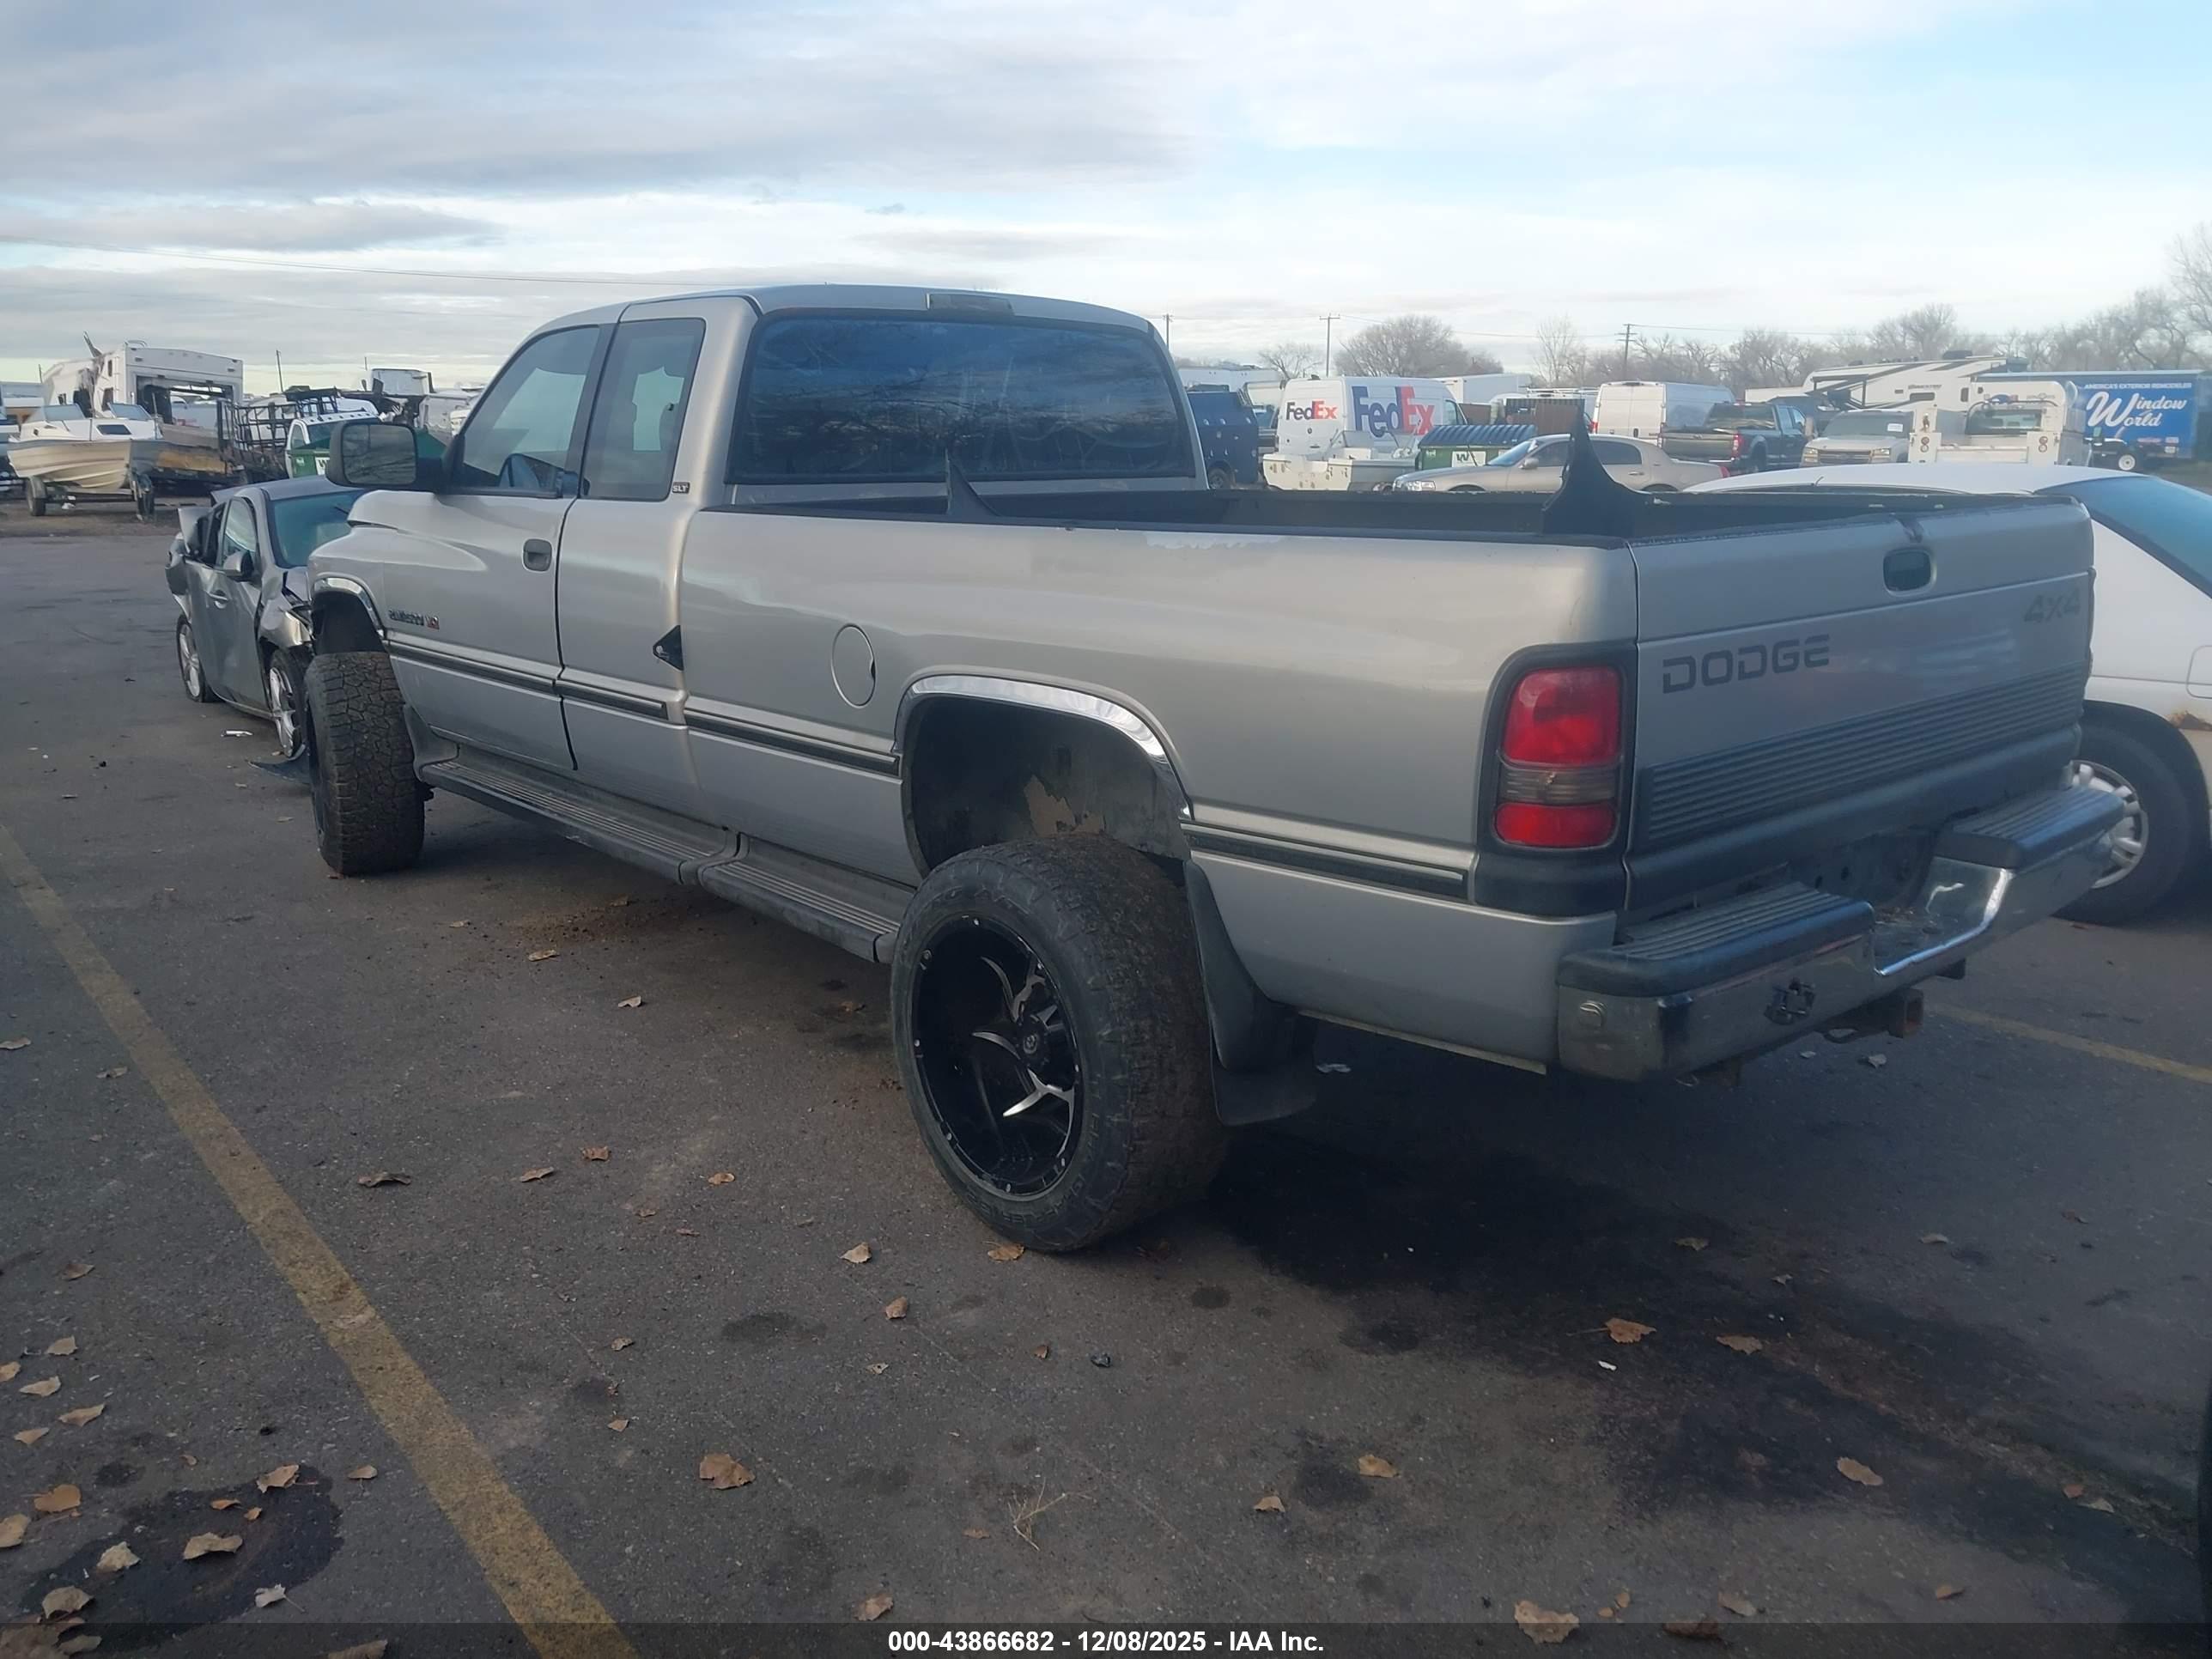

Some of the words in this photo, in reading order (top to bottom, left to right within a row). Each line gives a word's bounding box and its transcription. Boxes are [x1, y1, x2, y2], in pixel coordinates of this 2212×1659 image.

[1286, 399, 1337, 420] FedEx
[1352, 385, 1434, 438] FedEx
[2087, 392, 2187, 427] Window
[1662, 634, 1830, 694] DODGE
